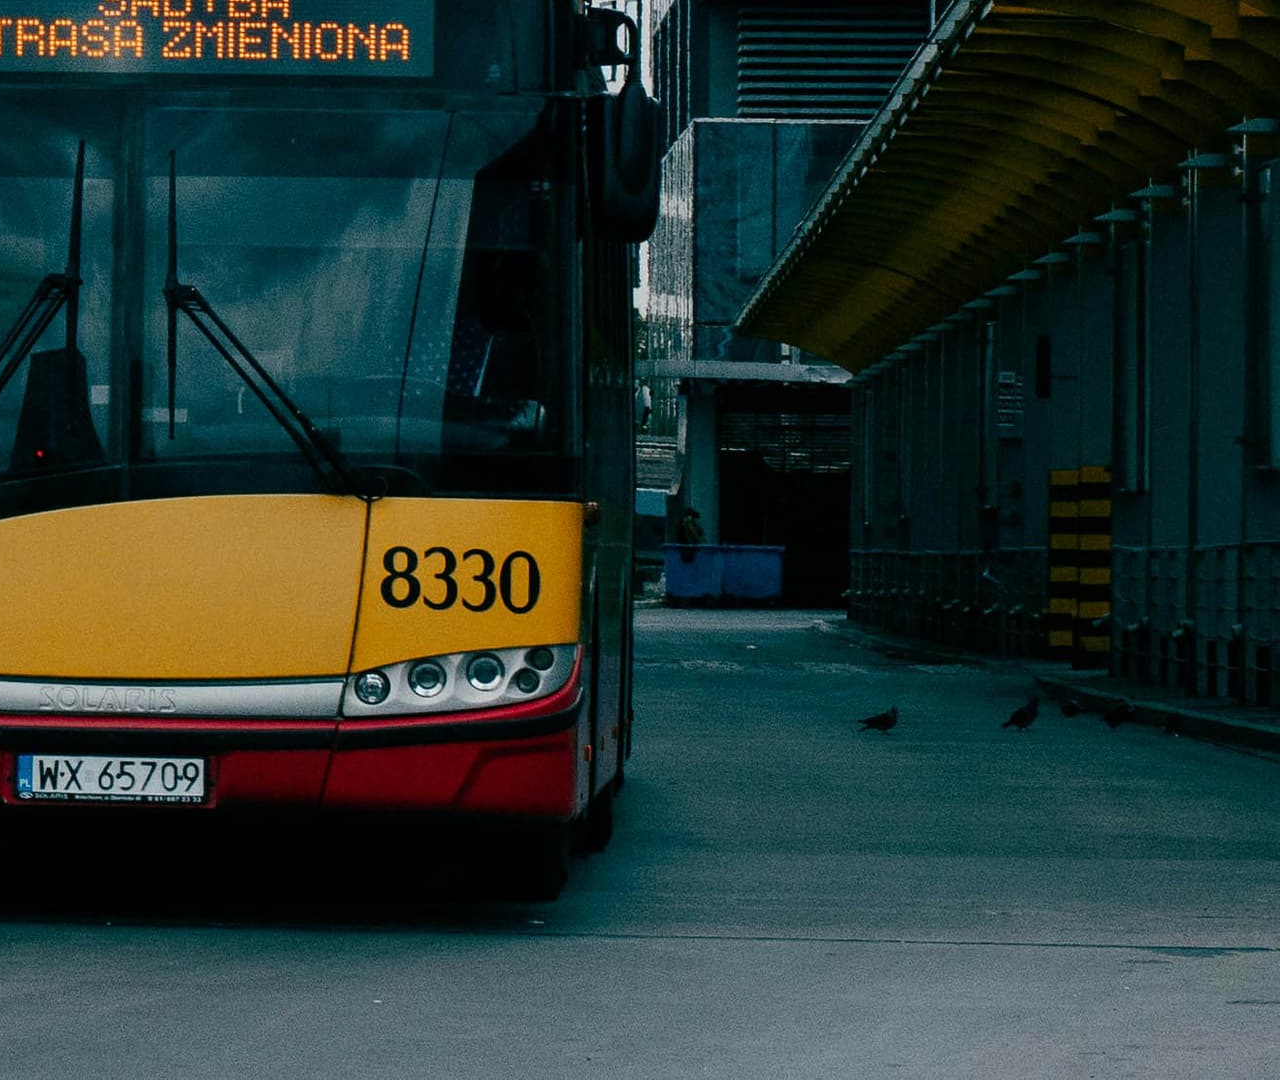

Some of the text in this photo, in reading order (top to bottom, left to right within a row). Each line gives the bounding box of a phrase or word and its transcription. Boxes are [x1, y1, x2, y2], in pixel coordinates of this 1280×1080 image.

[160, 21, 411, 62] ZMIENIONA
[381, 546, 540, 614] 8330
[39, 685, 177, 713] SOLARIS
[19, 778, 31, 788] PL
[39, 759, 200, 792] WX 65709
